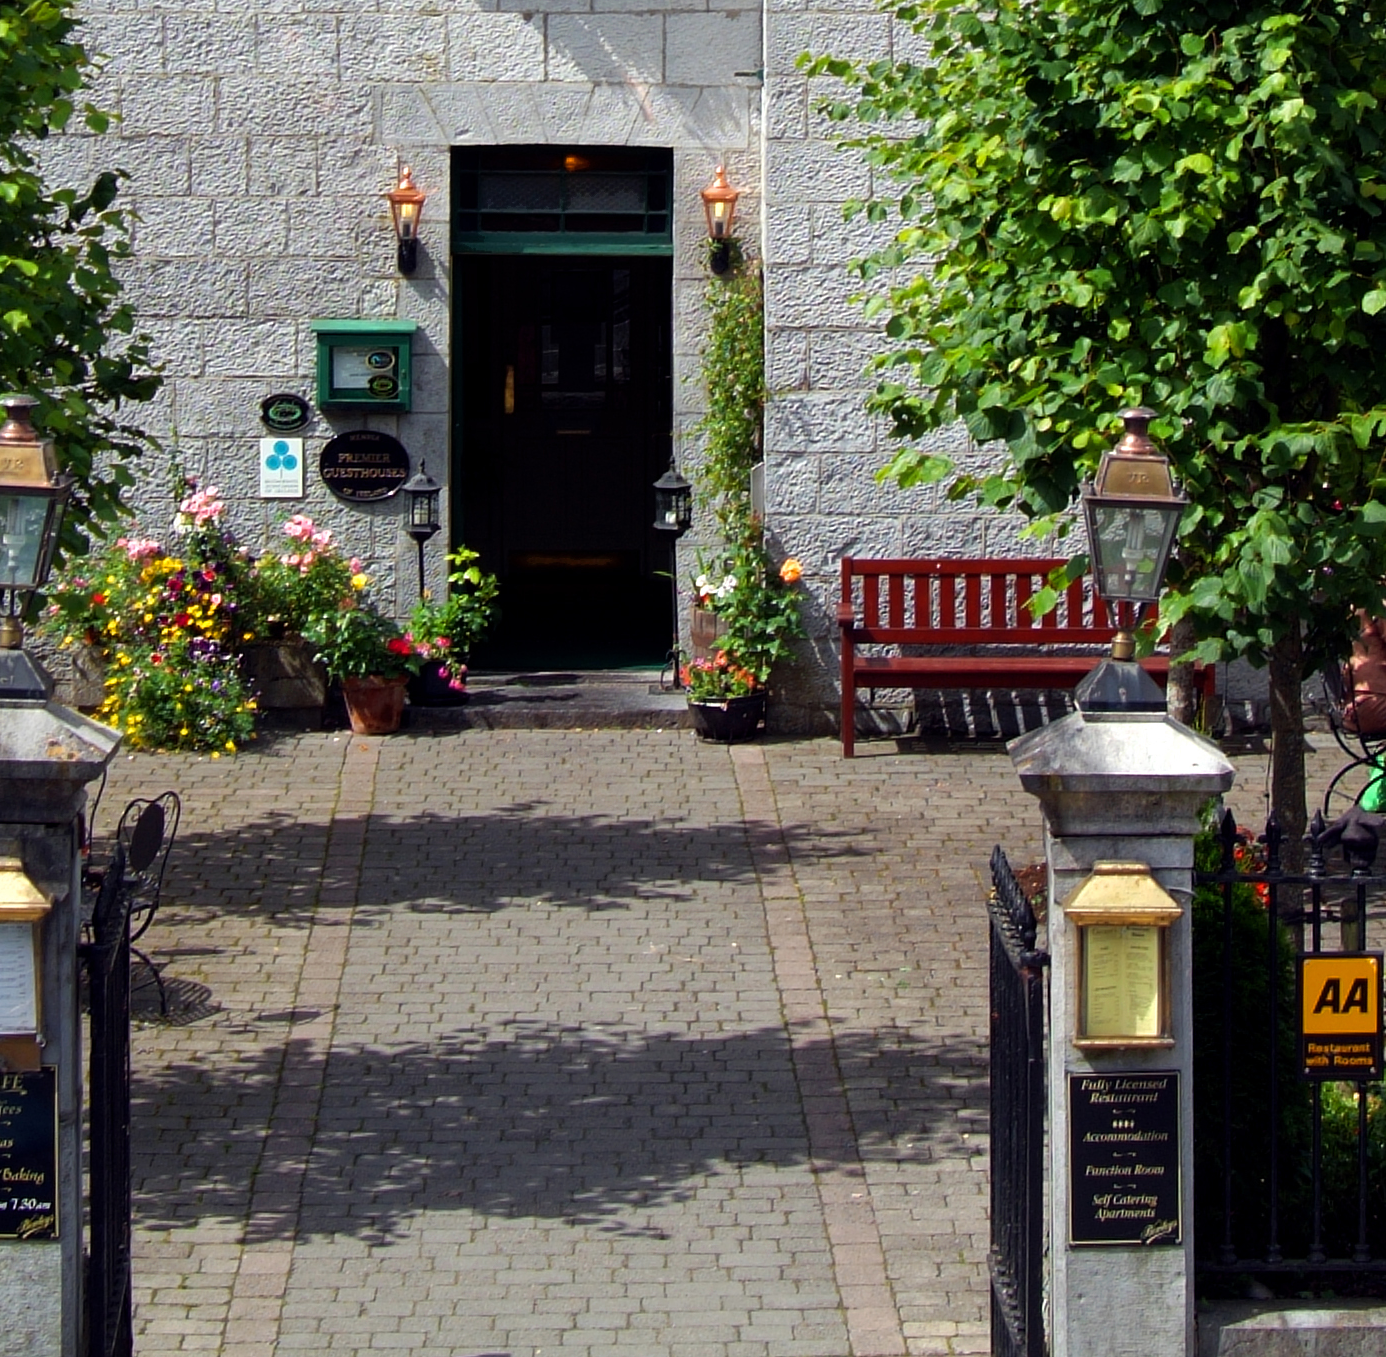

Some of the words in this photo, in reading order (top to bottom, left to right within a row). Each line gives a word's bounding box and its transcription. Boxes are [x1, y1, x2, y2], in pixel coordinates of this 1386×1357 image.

[338, 453, 390, 463] PREMIER
[323, 467, 406, 478] GUESTHOUSES
[1313, 978, 1369, 1014] AA
[1308, 1043, 1371, 1054] Restaurant
[1306, 1056, 1329, 1066] with
[1334, 1056, 1373, 1066] Rooms
[1081, 1079, 1112, 1092] Fully
[1115, 1079, 1167, 1090] Licensed
[1090, 1092, 1159, 1103] Restaurant
[1082, 1130, 1169, 1142] Accommodation
[1085, 1165, 1131, 1176] Function
[1134, 1164, 1165, 1175] Room
[1092, 1193, 1112, 1208] Self
[1113, 1193, 1158, 1207] Catering
[1095, 1208, 1156, 1222] Apartments
